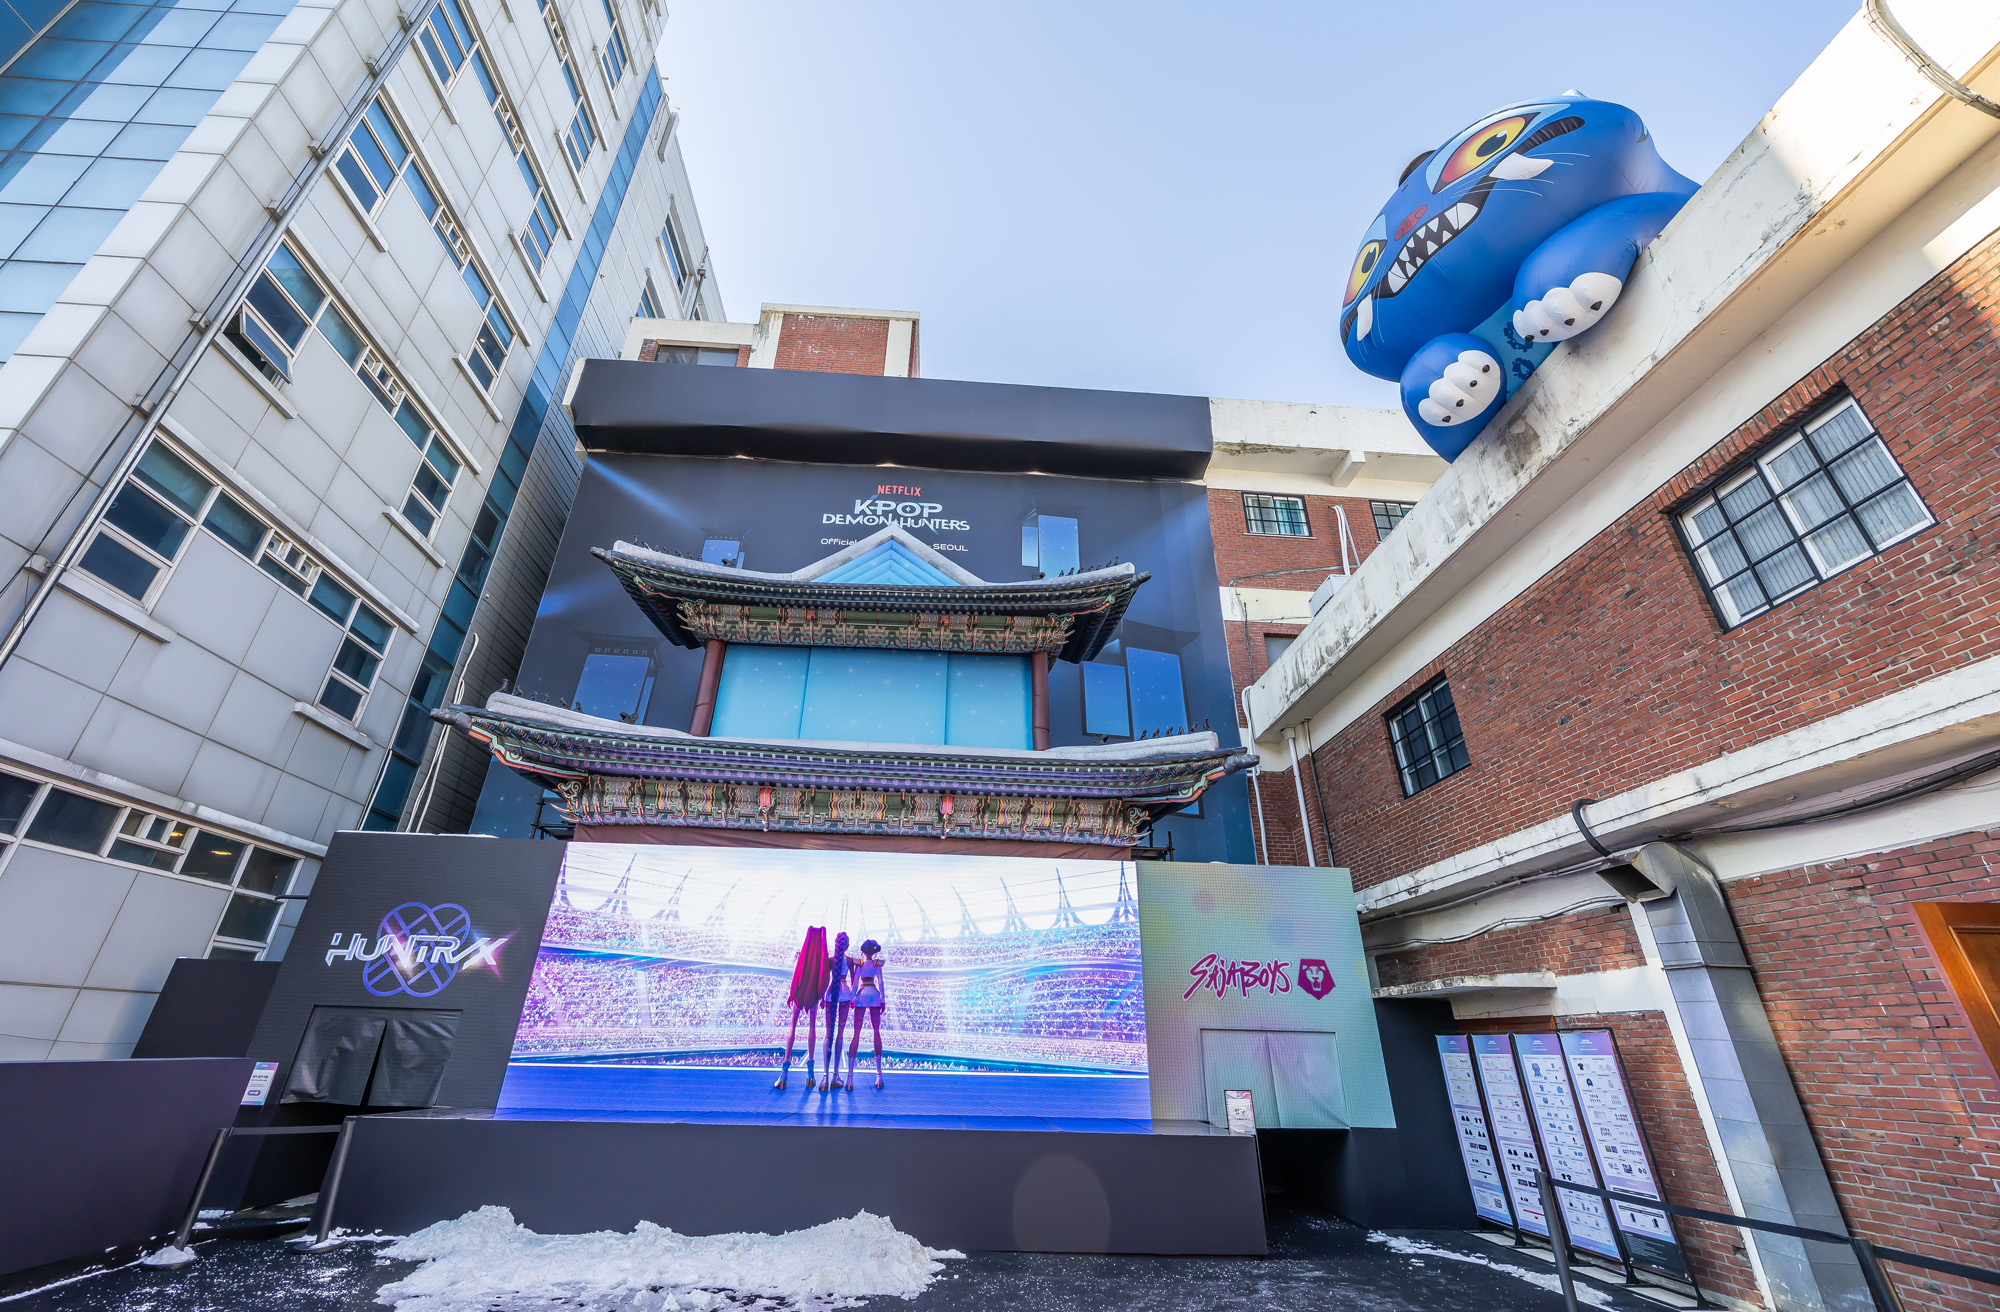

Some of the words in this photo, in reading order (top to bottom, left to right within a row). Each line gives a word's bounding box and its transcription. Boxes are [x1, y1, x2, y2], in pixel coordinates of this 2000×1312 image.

[877, 484, 922, 497] NETFLIX
[822, 513, 893, 527] DEMON
[900, 516, 971, 533] HUNTERS
[932, 543, 969, 552] SEOUL
